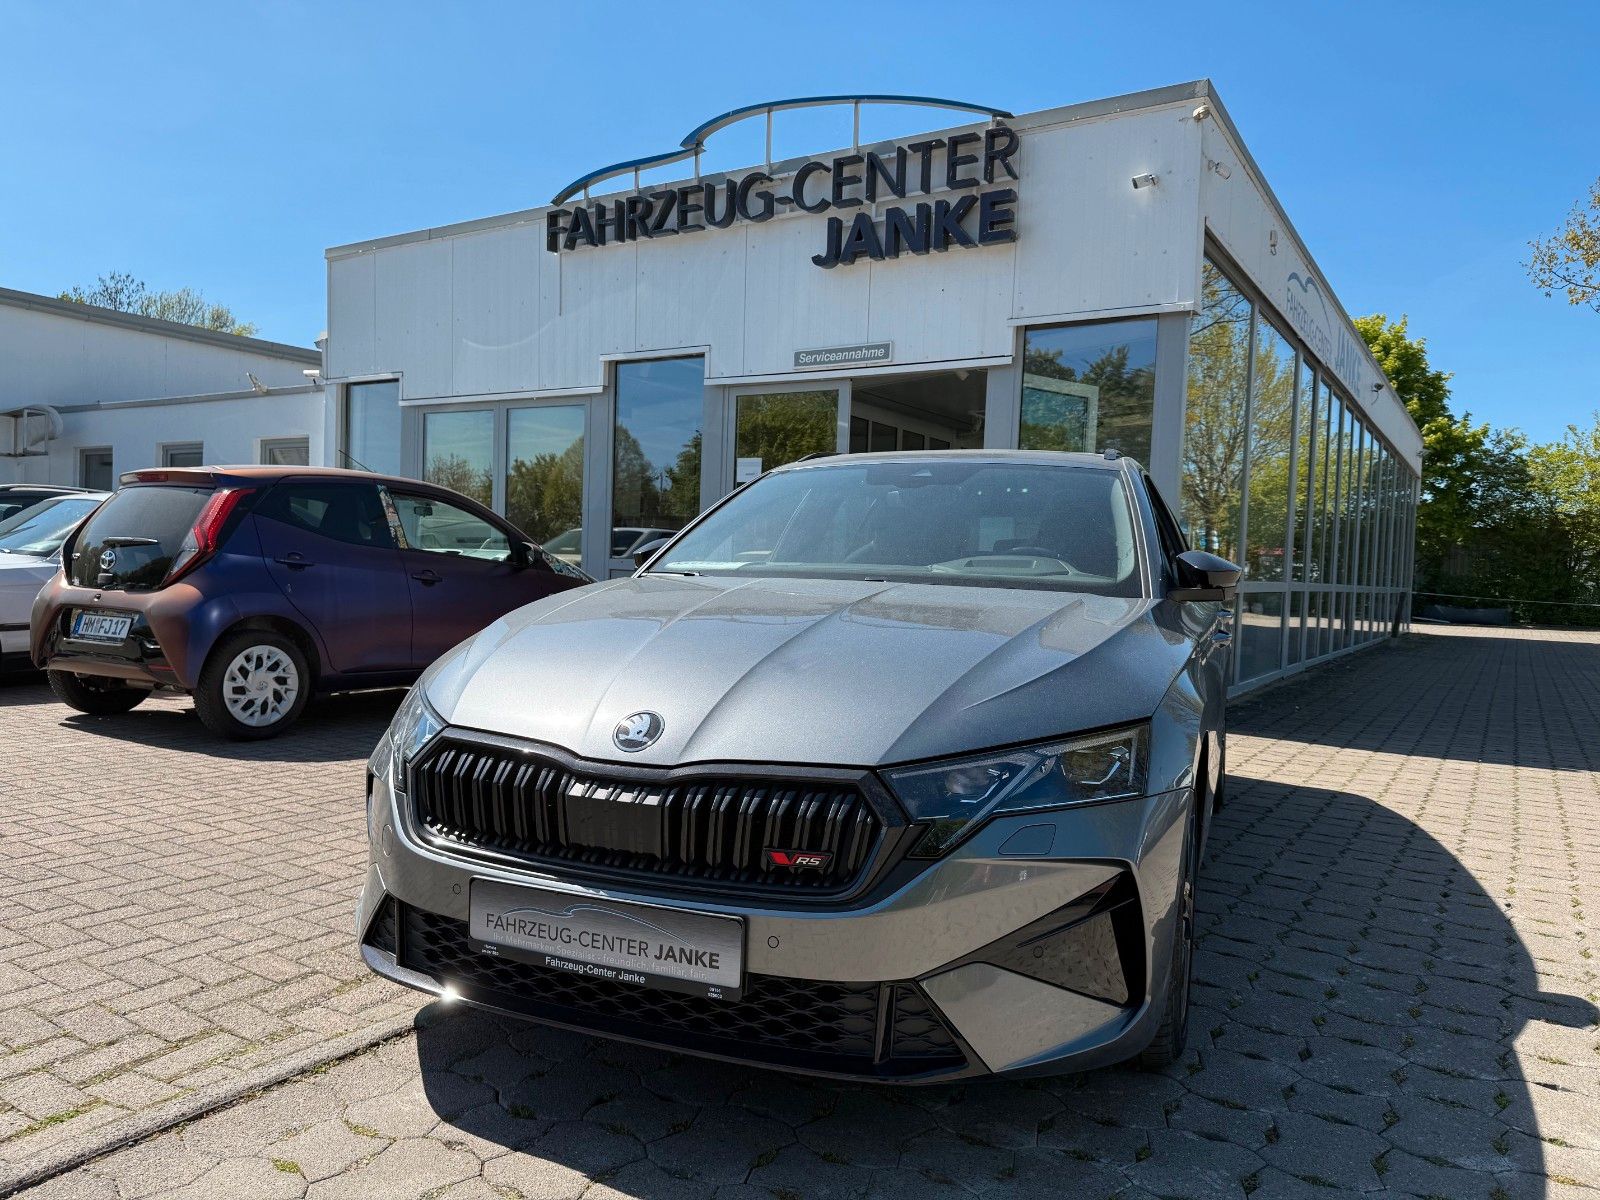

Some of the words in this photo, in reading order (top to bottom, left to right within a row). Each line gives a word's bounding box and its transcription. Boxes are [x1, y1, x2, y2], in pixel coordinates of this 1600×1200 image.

[546, 127, 1019, 253] FAHRZEUG-CENTER
[811, 188, 1018, 269] JANKE
[798, 347, 885, 364] Serviceannahme
[486, 913, 649, 958] FAHRZEUG-CENTER
[654, 944, 720, 970] JANKE
[545, 956, 616, 978] Fahrzeug-Center
[618, 967, 646, 984] Janke
